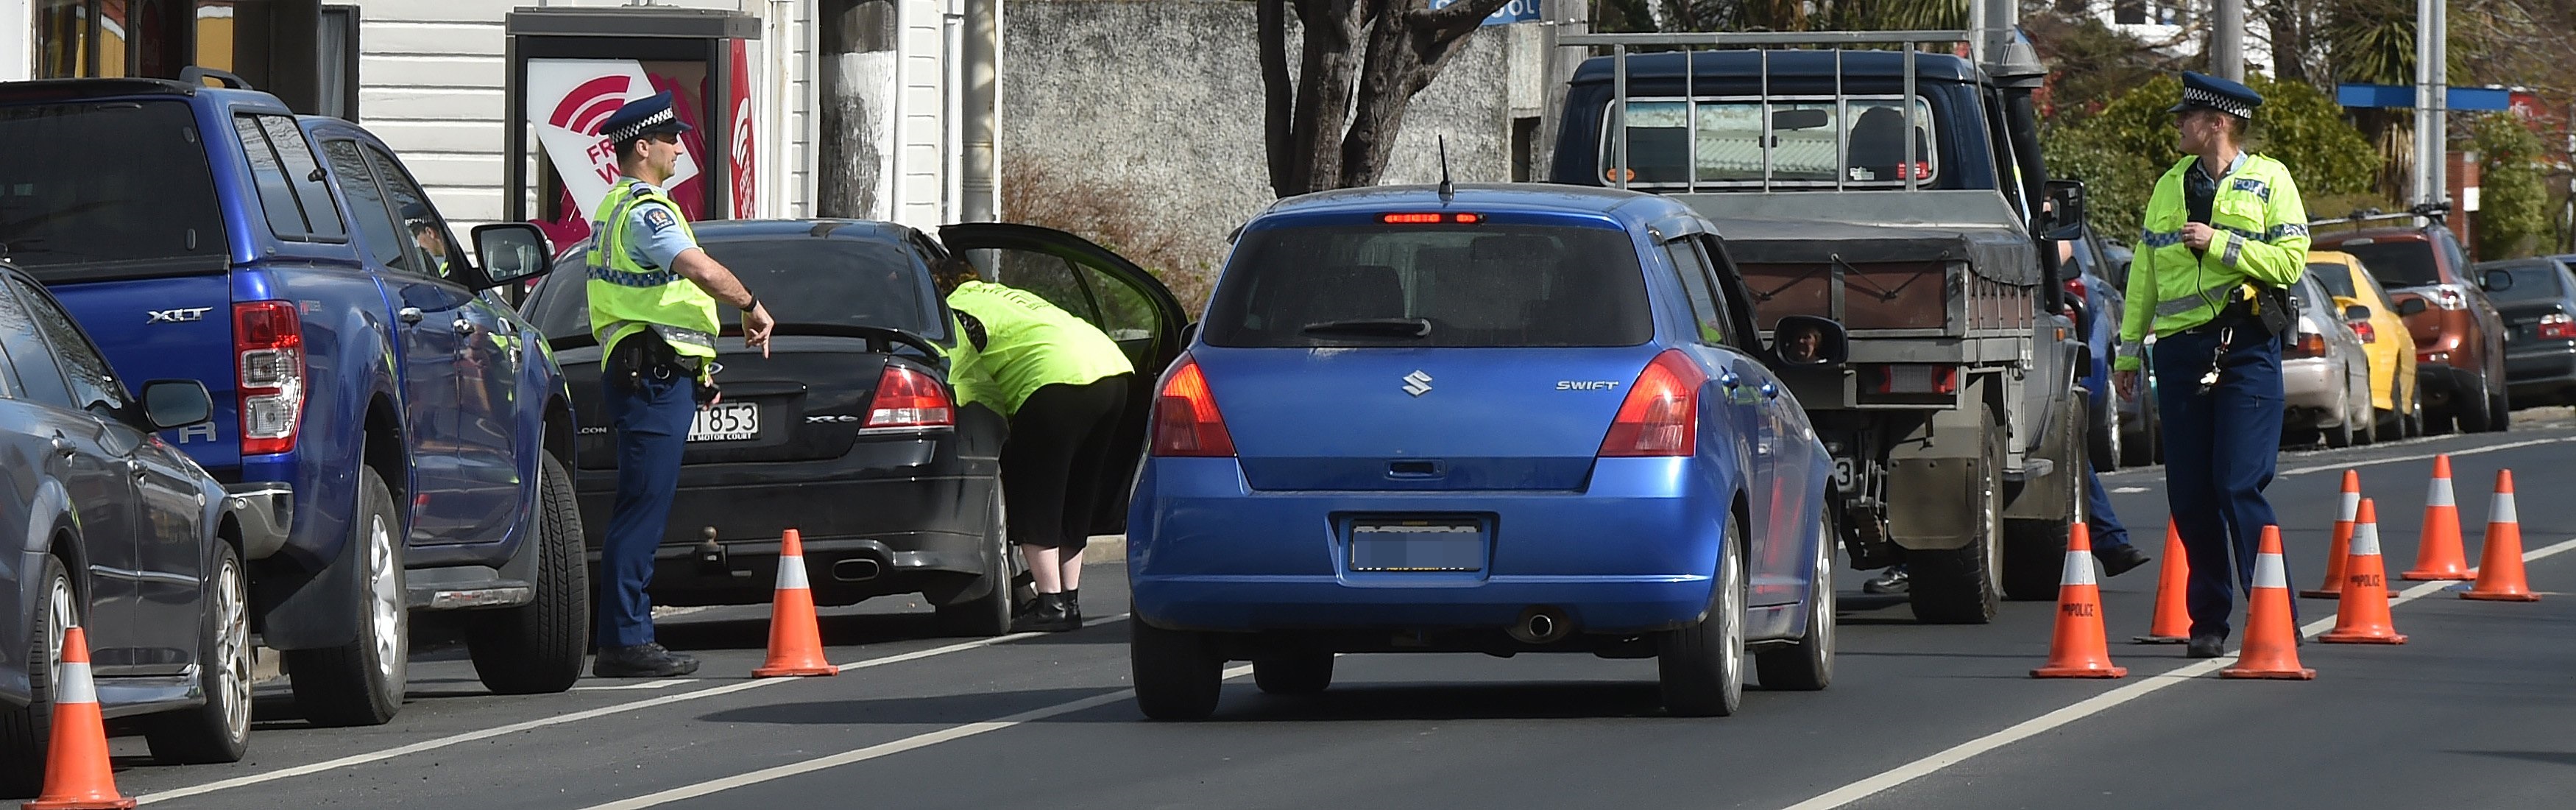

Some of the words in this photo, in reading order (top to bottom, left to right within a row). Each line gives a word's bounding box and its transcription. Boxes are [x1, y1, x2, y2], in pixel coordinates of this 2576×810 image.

[146, 307, 213, 324] XLT
[1556, 381, 1619, 390] SWIFT
[806, 415, 858, 424] XR6
[698, 433, 725, 441] MOTOR
[727, 432, 751, 440] COURT
